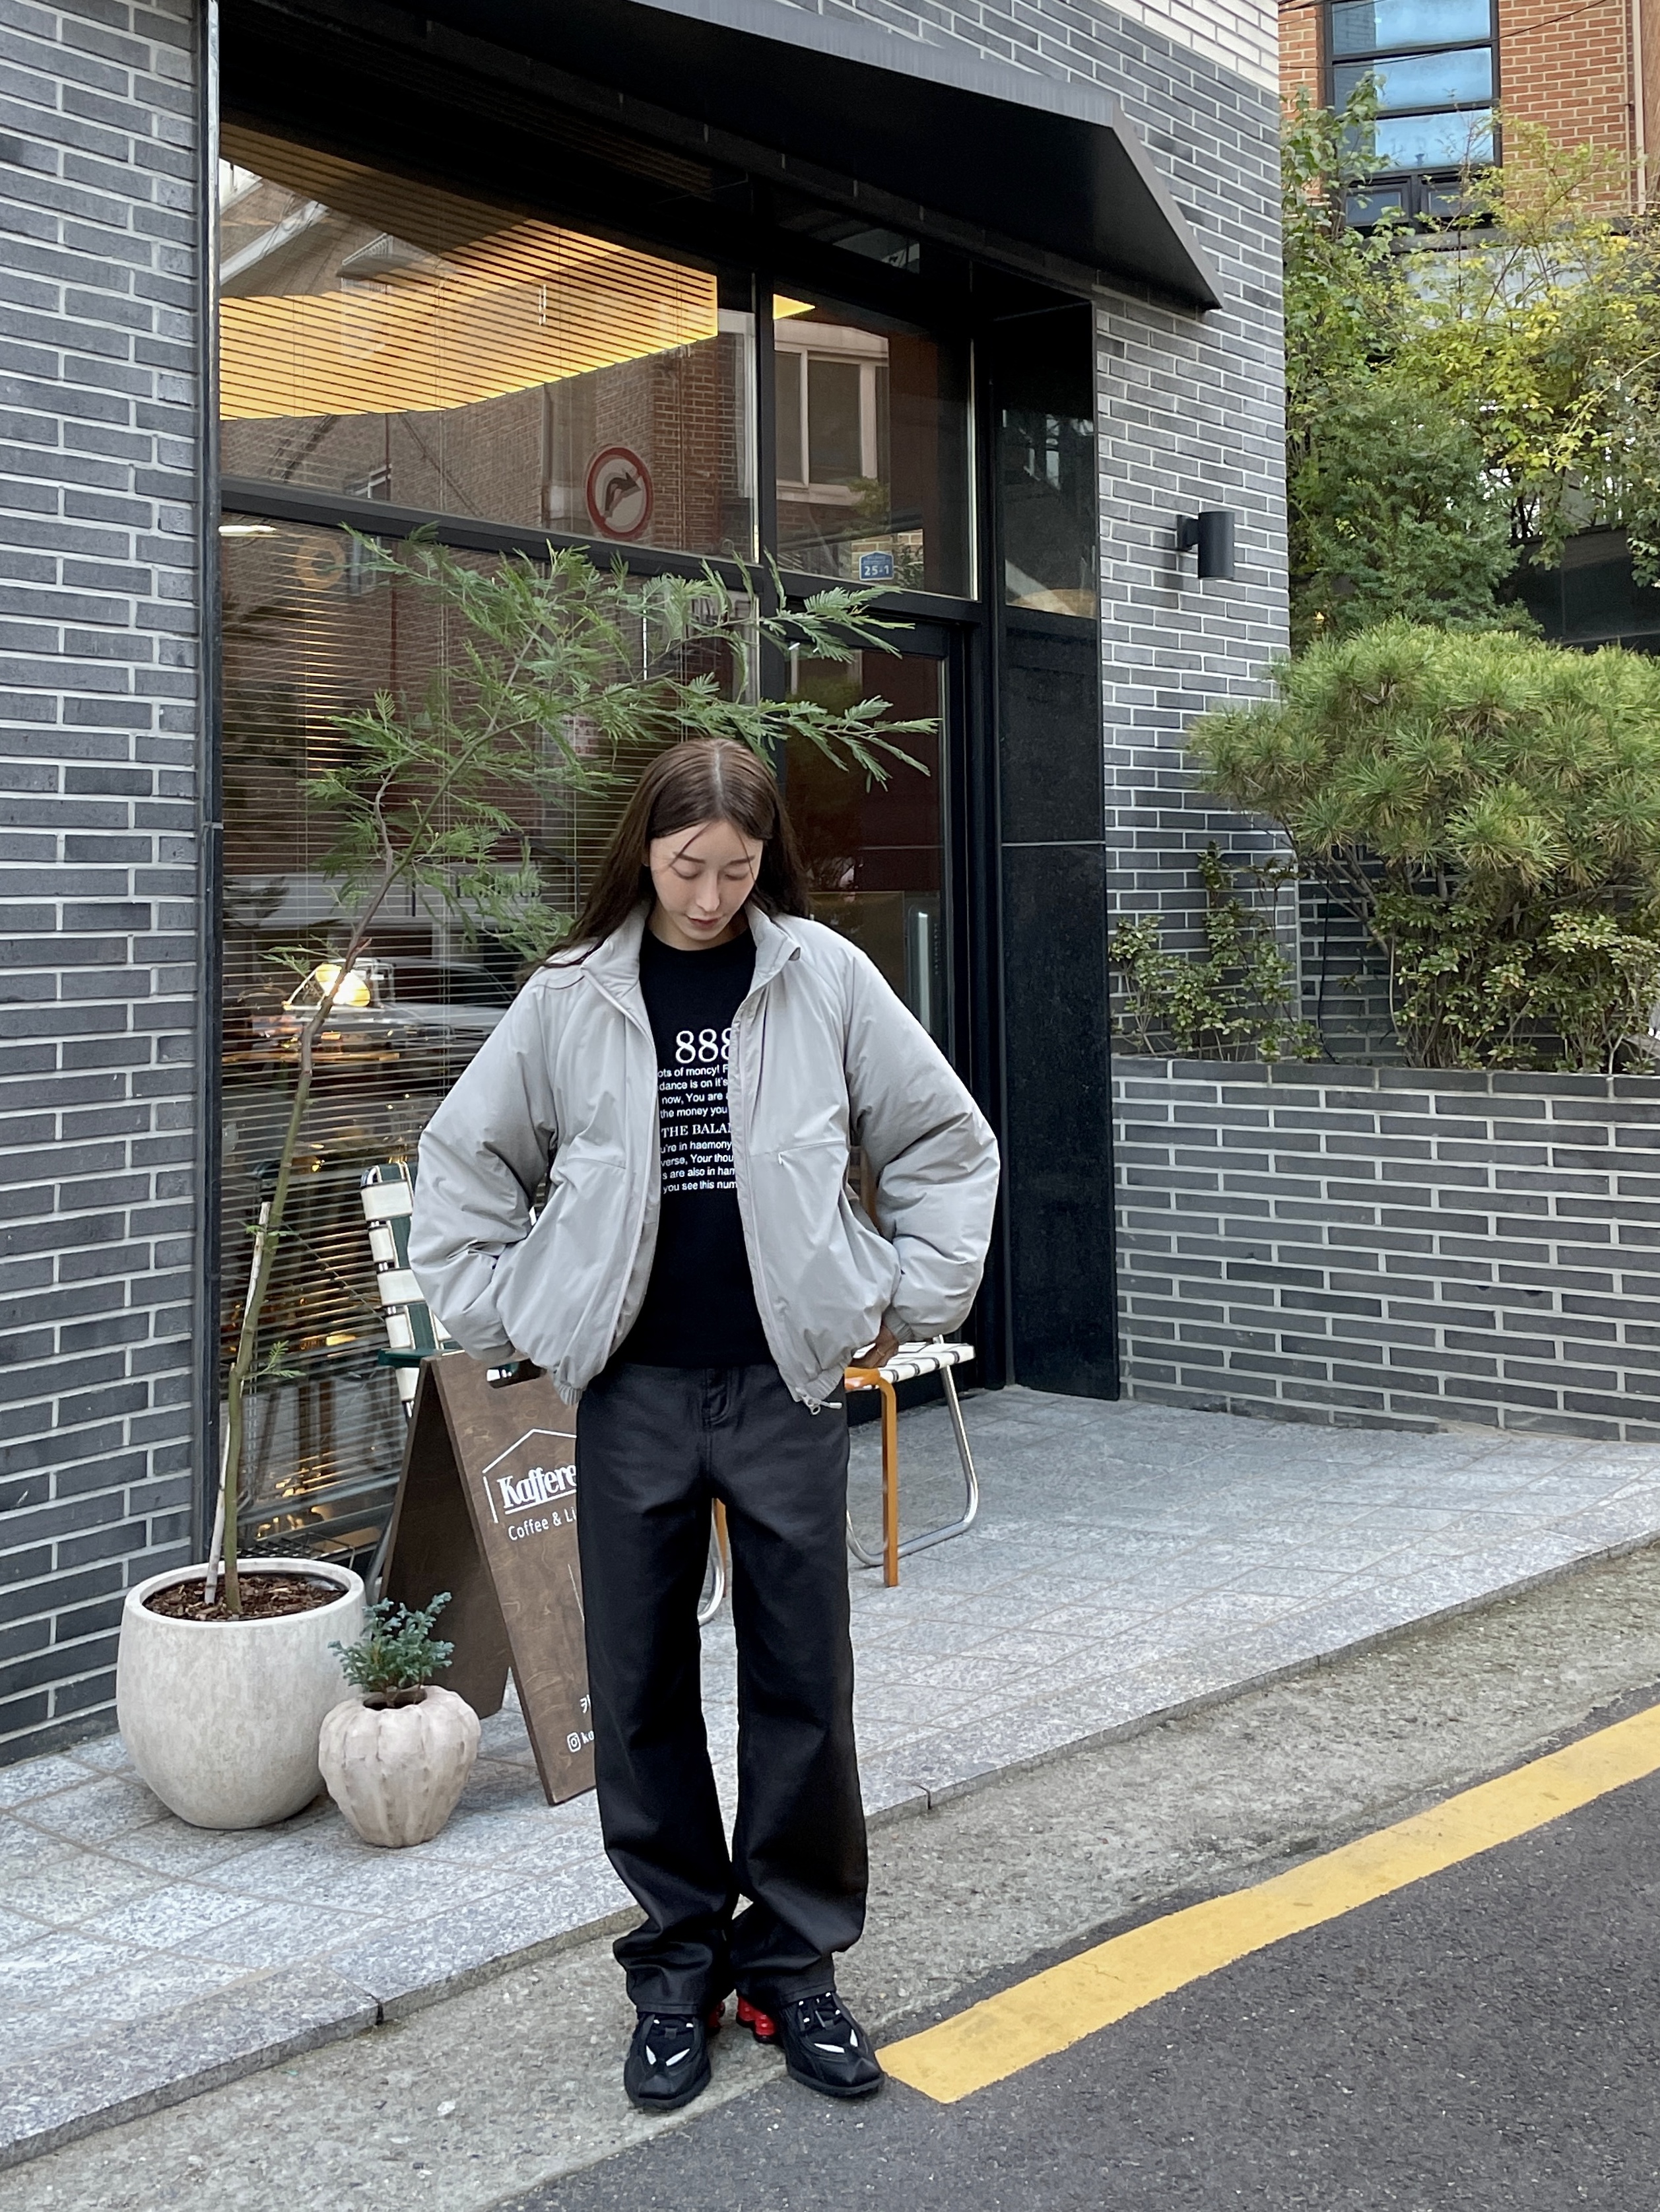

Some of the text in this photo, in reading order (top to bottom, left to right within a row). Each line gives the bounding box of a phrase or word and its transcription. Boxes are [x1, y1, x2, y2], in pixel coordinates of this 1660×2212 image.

[864, 565, 890, 576] 25-1
[658, 1068, 672, 1077] ots
[674, 1067, 684, 1077] of
[659, 1081, 687, 1091] dance
[690, 1079, 698, 1089] is
[715, 1077, 728, 1087] it's
[685, 1093, 705, 1102] You
[708, 1092, 723, 1101] are
[660, 1106, 728, 1119] the money you
[661, 1125, 688, 1138] THE
[679, 1142, 687, 1151] in
[690, 1154, 713, 1163] Your
[714, 1153, 733, 1162] thou
[687, 1167, 705, 1176] also
[707, 1166, 715, 1176] in
[663, 1184, 679, 1194] you
[700, 1180, 714, 1190] this
[508, 1507, 576, 1541] Coffee & Li
